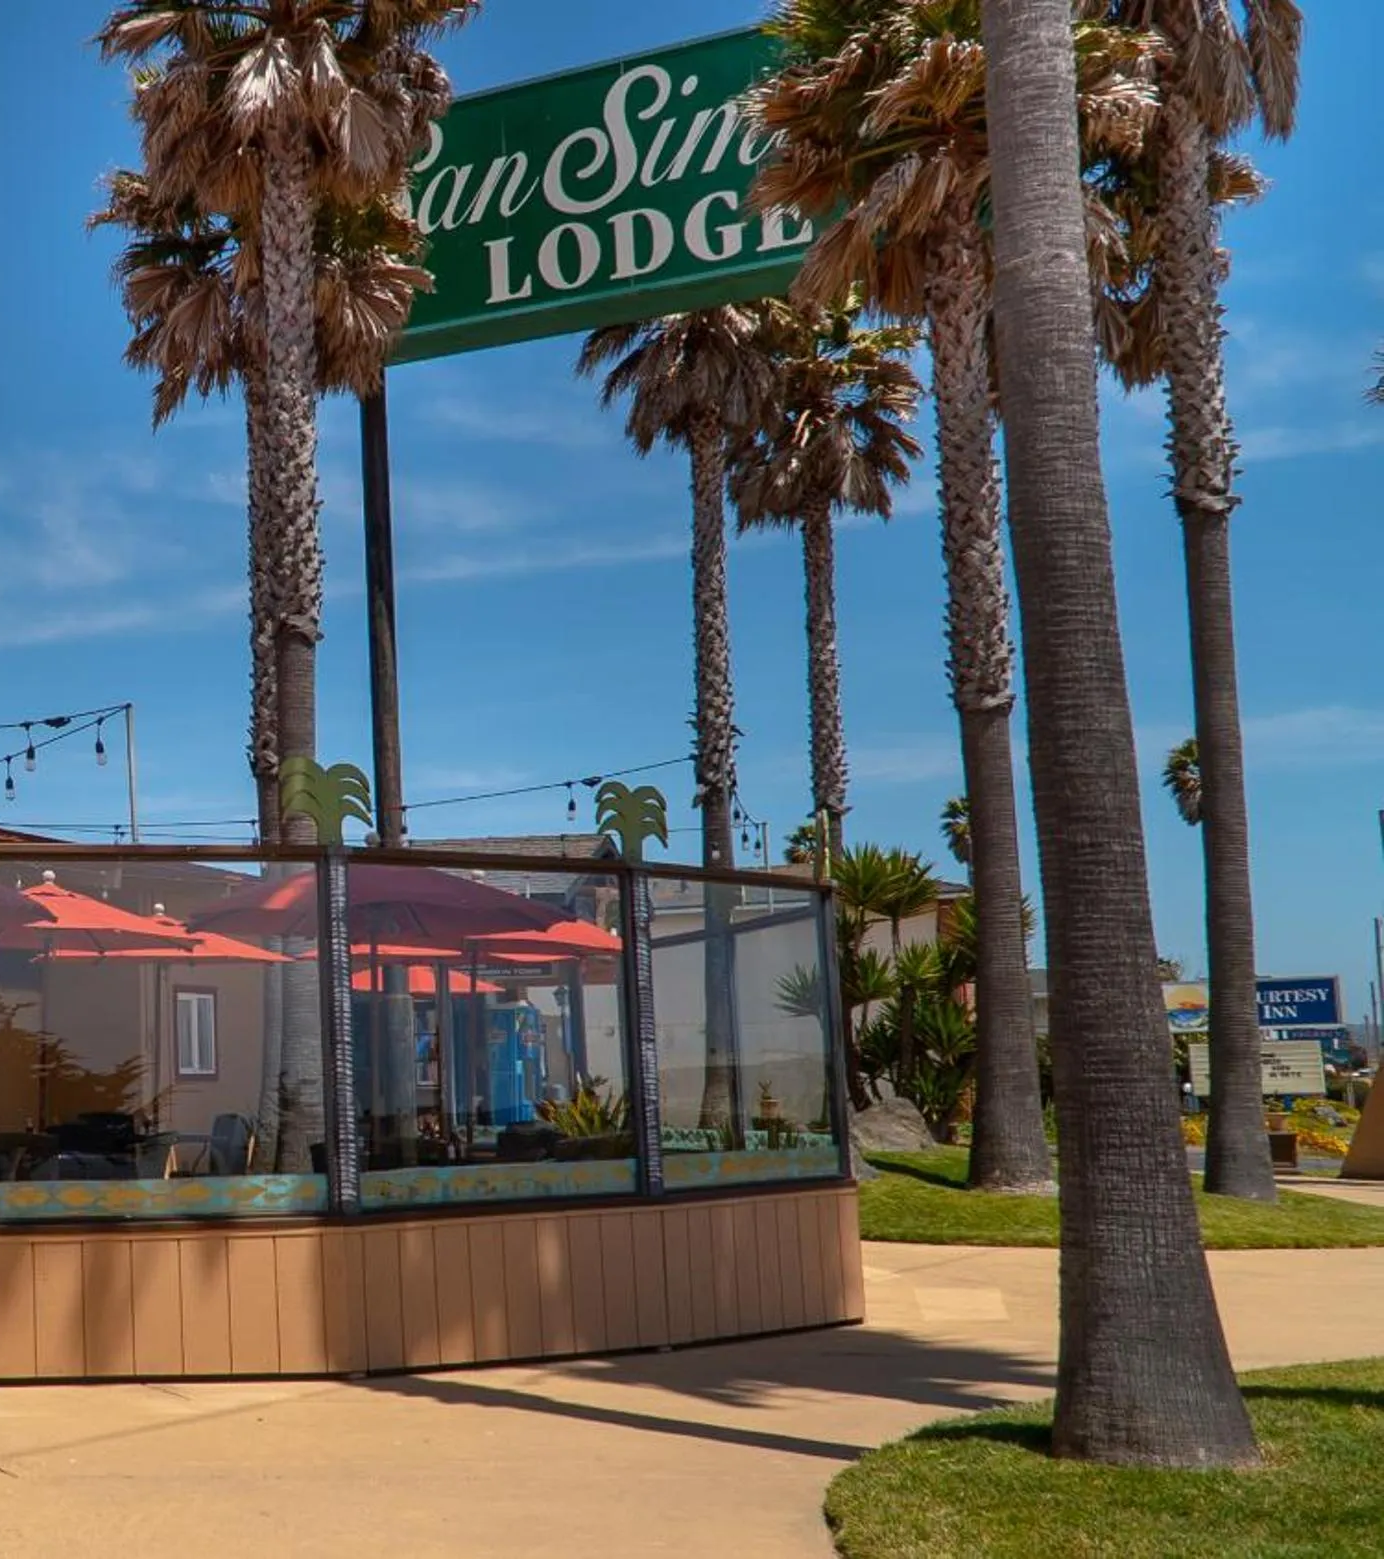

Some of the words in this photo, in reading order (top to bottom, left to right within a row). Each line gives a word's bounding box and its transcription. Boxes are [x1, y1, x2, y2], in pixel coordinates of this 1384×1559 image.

[543, 64, 791, 215] Sim
[484, 191, 813, 304] LODGE
[1256, 988, 1329, 1004] URTESY
[1263, 1005, 1298, 1019] INN
